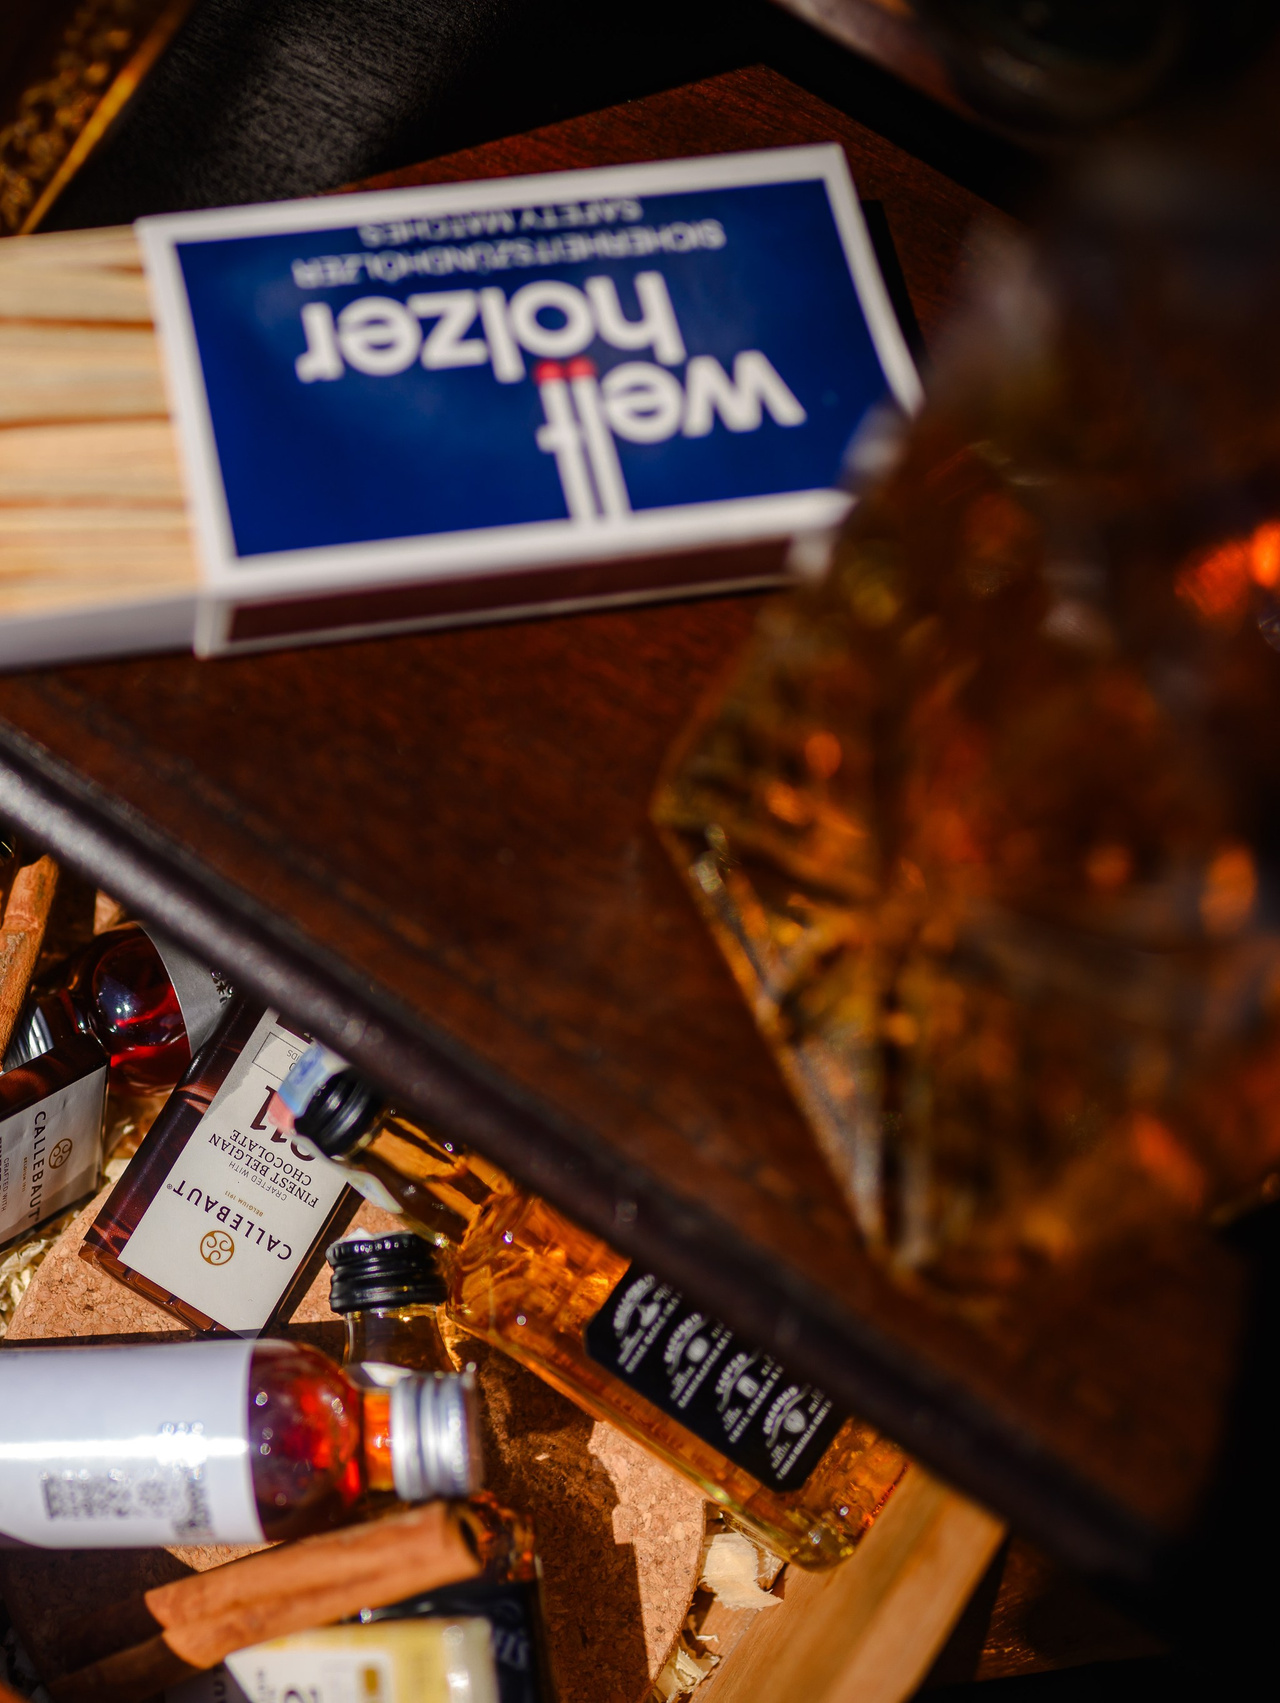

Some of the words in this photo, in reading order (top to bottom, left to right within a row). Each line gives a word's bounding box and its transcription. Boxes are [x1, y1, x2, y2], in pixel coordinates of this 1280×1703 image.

[295, 271, 686, 384] holzer
[208, 1133, 271, 1178] BELGIAN
[228, 1161, 250, 1178] WITH
[229, 1129, 312, 1187] CHOCOLATE
[2, 1157, 10, 1192] CRAFTED
[251, 1175, 288, 1201] CRAFTED
[270, 1172, 320, 1209] FINEST
[224, 1190, 237, 1201] 1911
[237, 1198, 264, 1217] BELGIUM
